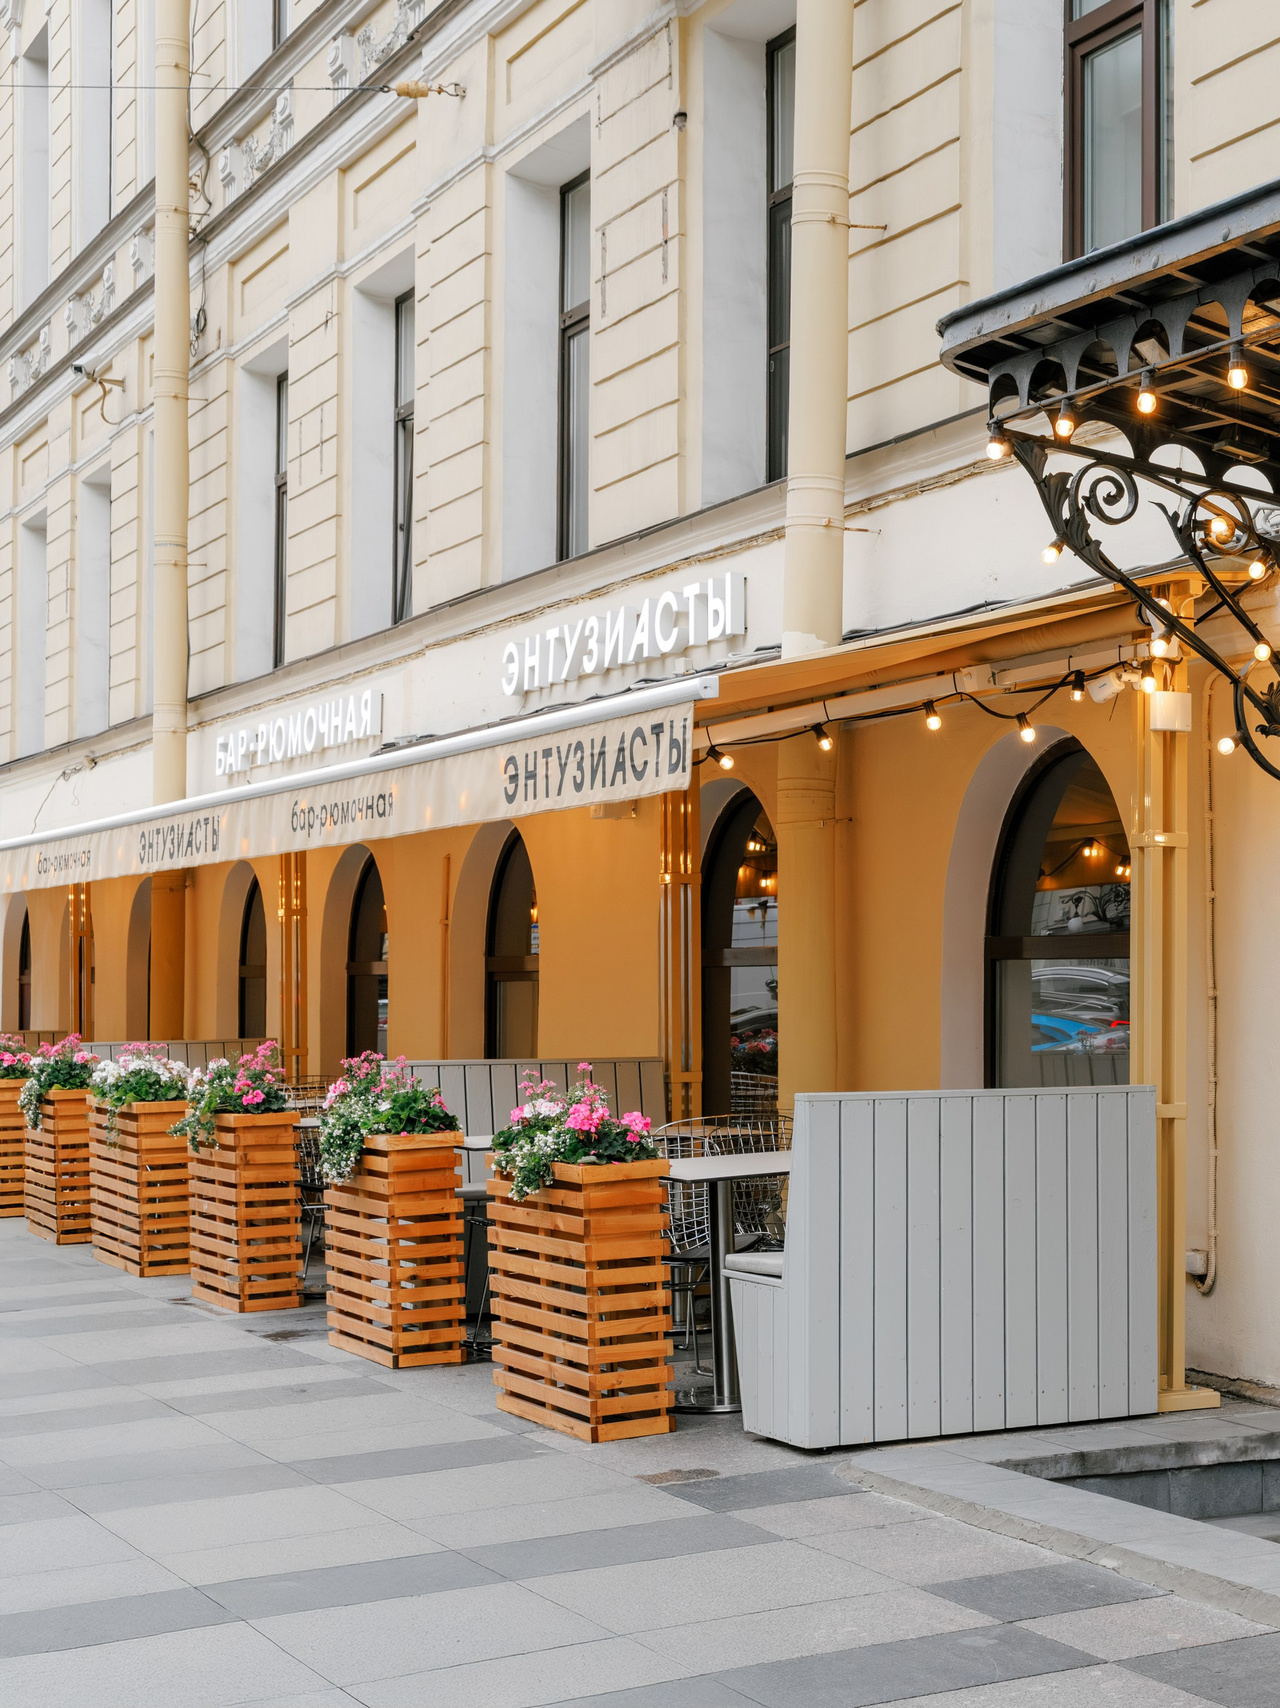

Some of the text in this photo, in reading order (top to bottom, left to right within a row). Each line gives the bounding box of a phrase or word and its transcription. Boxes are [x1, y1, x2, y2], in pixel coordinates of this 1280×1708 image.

[501, 571, 740, 696] ЭНТУЗИАСТЫ
[215, 689, 374, 776] БАР-РЮМОЧНАЯ
[503, 717, 688, 805] ЭНТУЗИАСТЫ
[138, 814, 220, 865] ЭНТУЗИАСТЫ
[290, 791, 394, 838] бар-рюмочная
